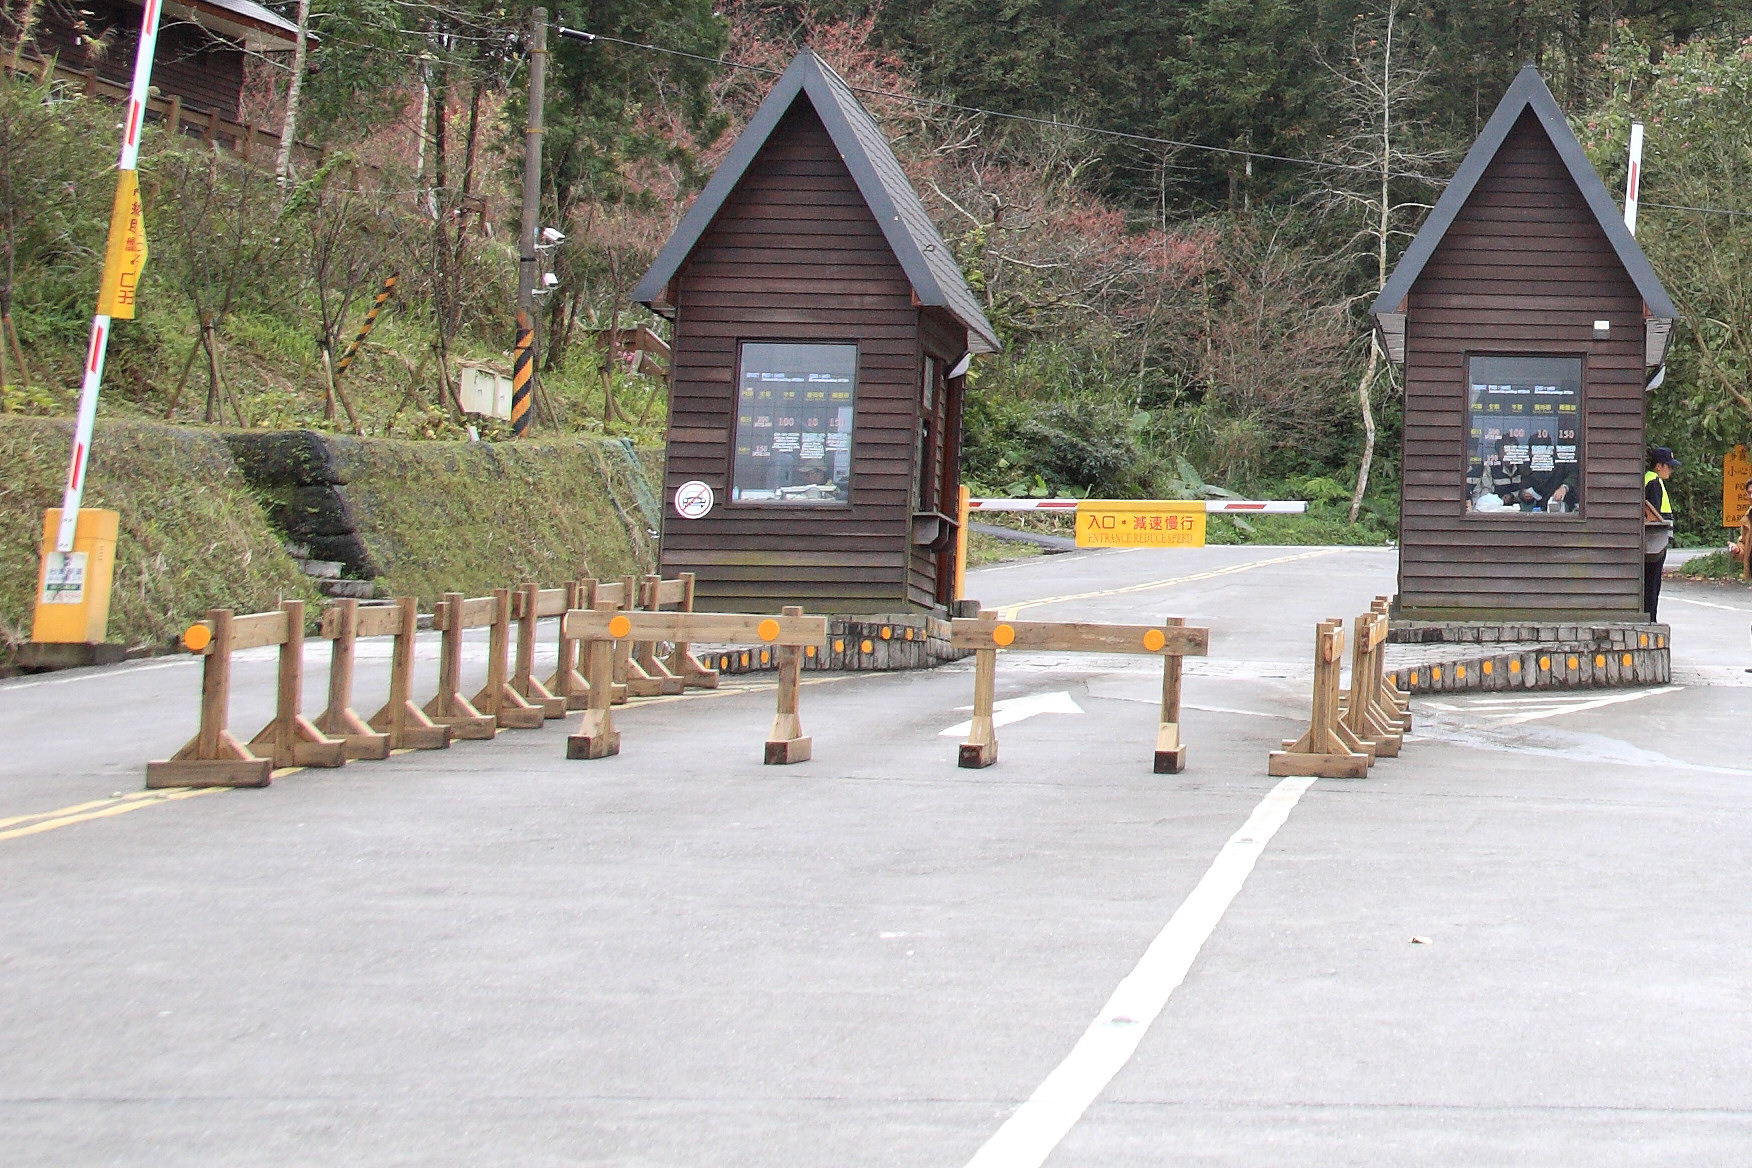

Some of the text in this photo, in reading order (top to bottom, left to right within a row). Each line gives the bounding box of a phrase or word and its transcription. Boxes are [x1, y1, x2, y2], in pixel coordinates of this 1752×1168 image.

[1538, 429, 1548, 438] 10
[1559, 430, 1575, 439] 150
[1088, 533, 1193, 544] ENTRANCE REDUCE SPEED
